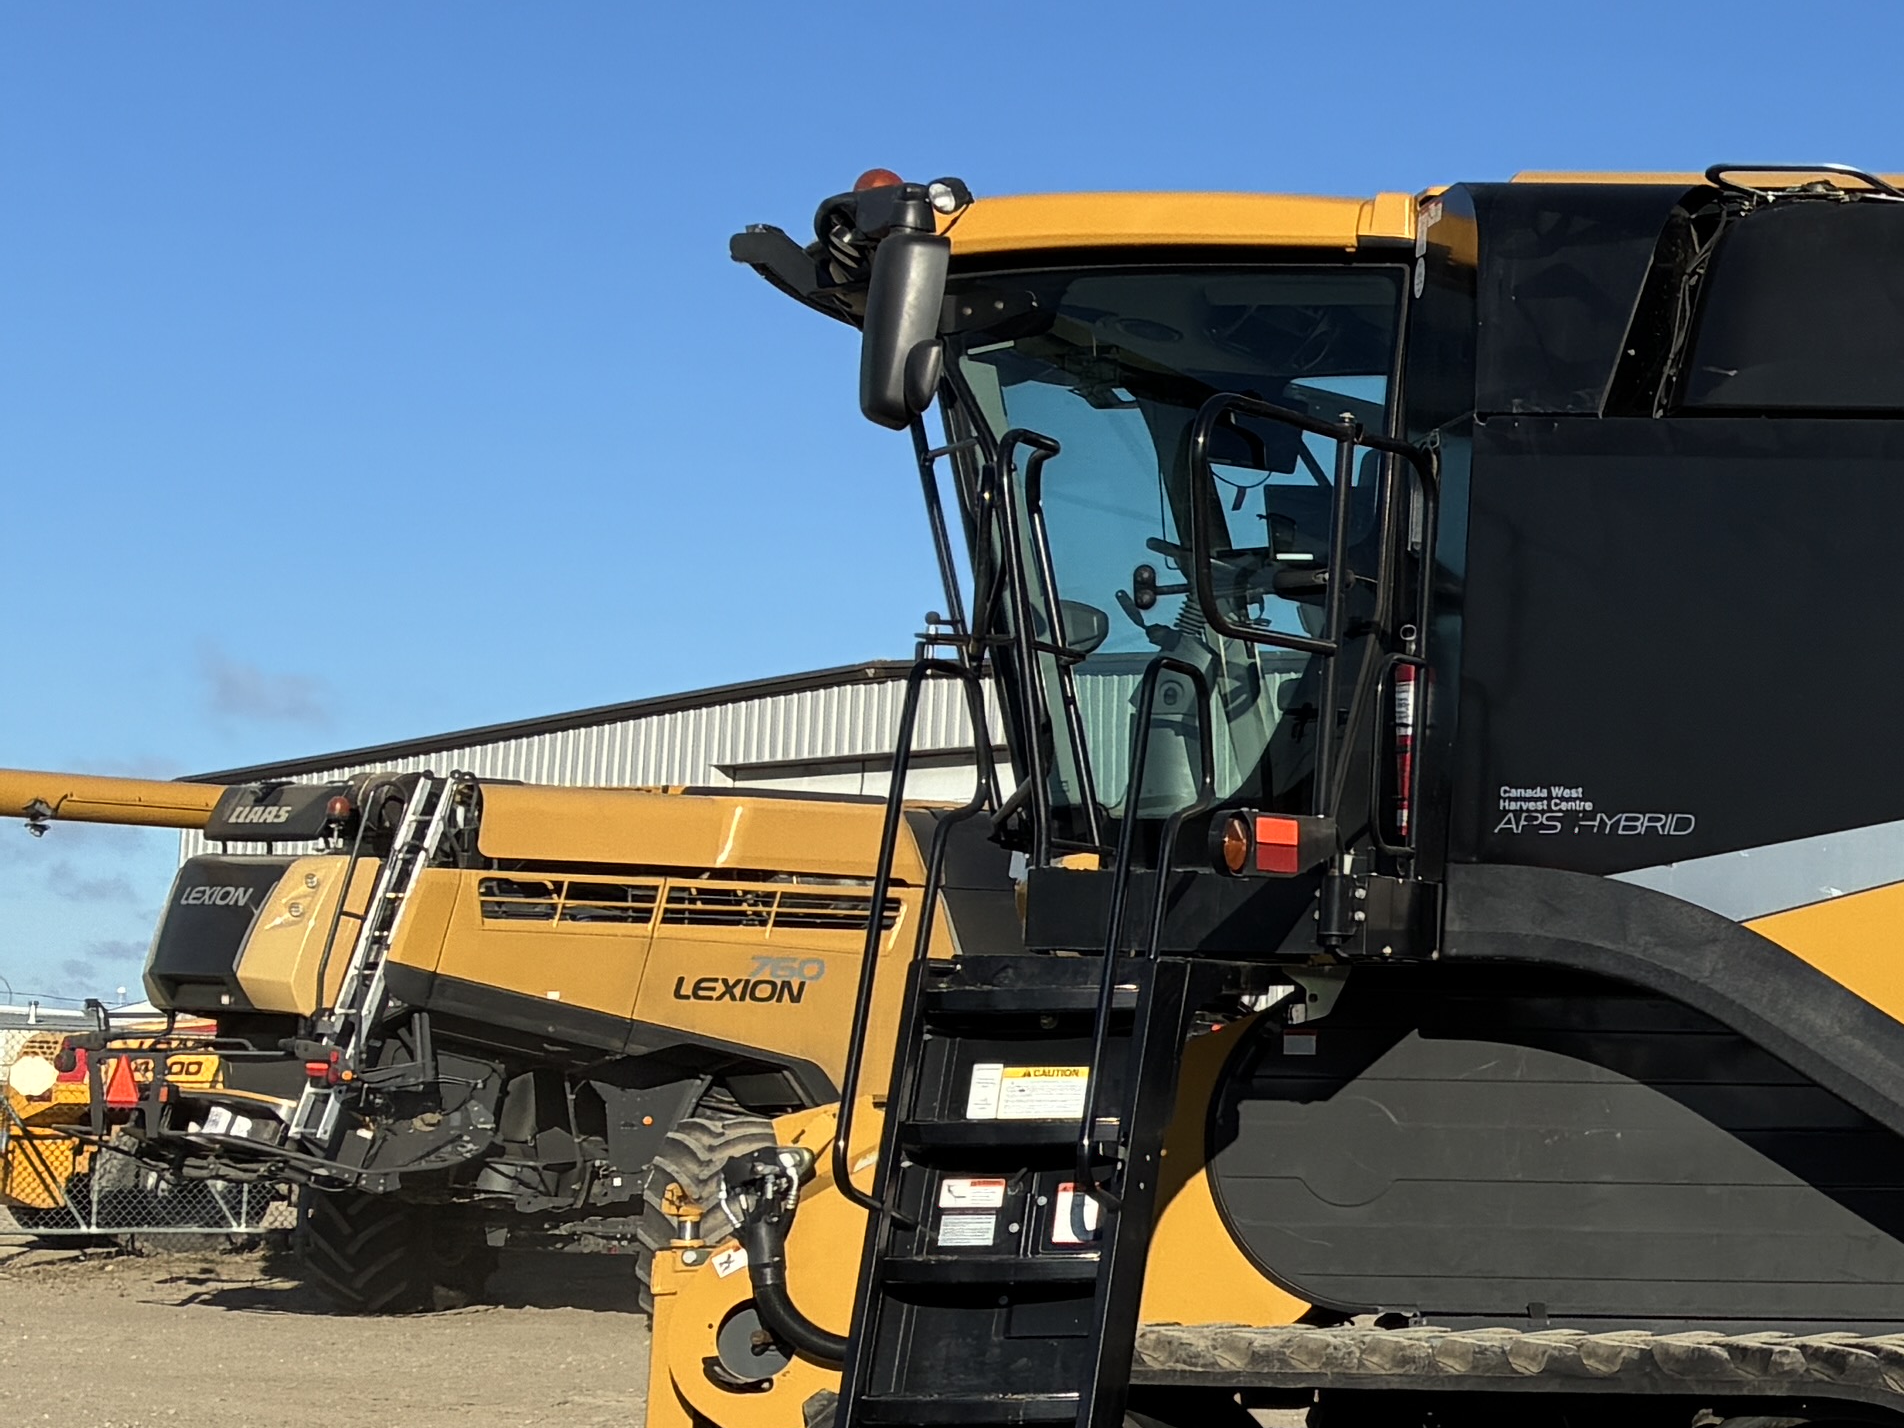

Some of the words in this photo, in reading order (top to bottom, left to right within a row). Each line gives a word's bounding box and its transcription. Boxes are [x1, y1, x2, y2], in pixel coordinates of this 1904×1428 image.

[1499, 785, 1548, 798] Canada
[1550, 785, 1583, 798] West
[227, 805, 292, 823] CLAAS
[1499, 798, 1548, 811] Harvest
[1550, 798, 1593, 811] Centre
[1494, 812, 1564, 834] APS
[1573, 812, 1696, 835] HYBRID
[181, 886, 254, 906] LEXION
[749, 955, 826, 982] 760
[673, 976, 807, 1004] LEXION
[1033, 1068, 1080, 1078] CAUTION
